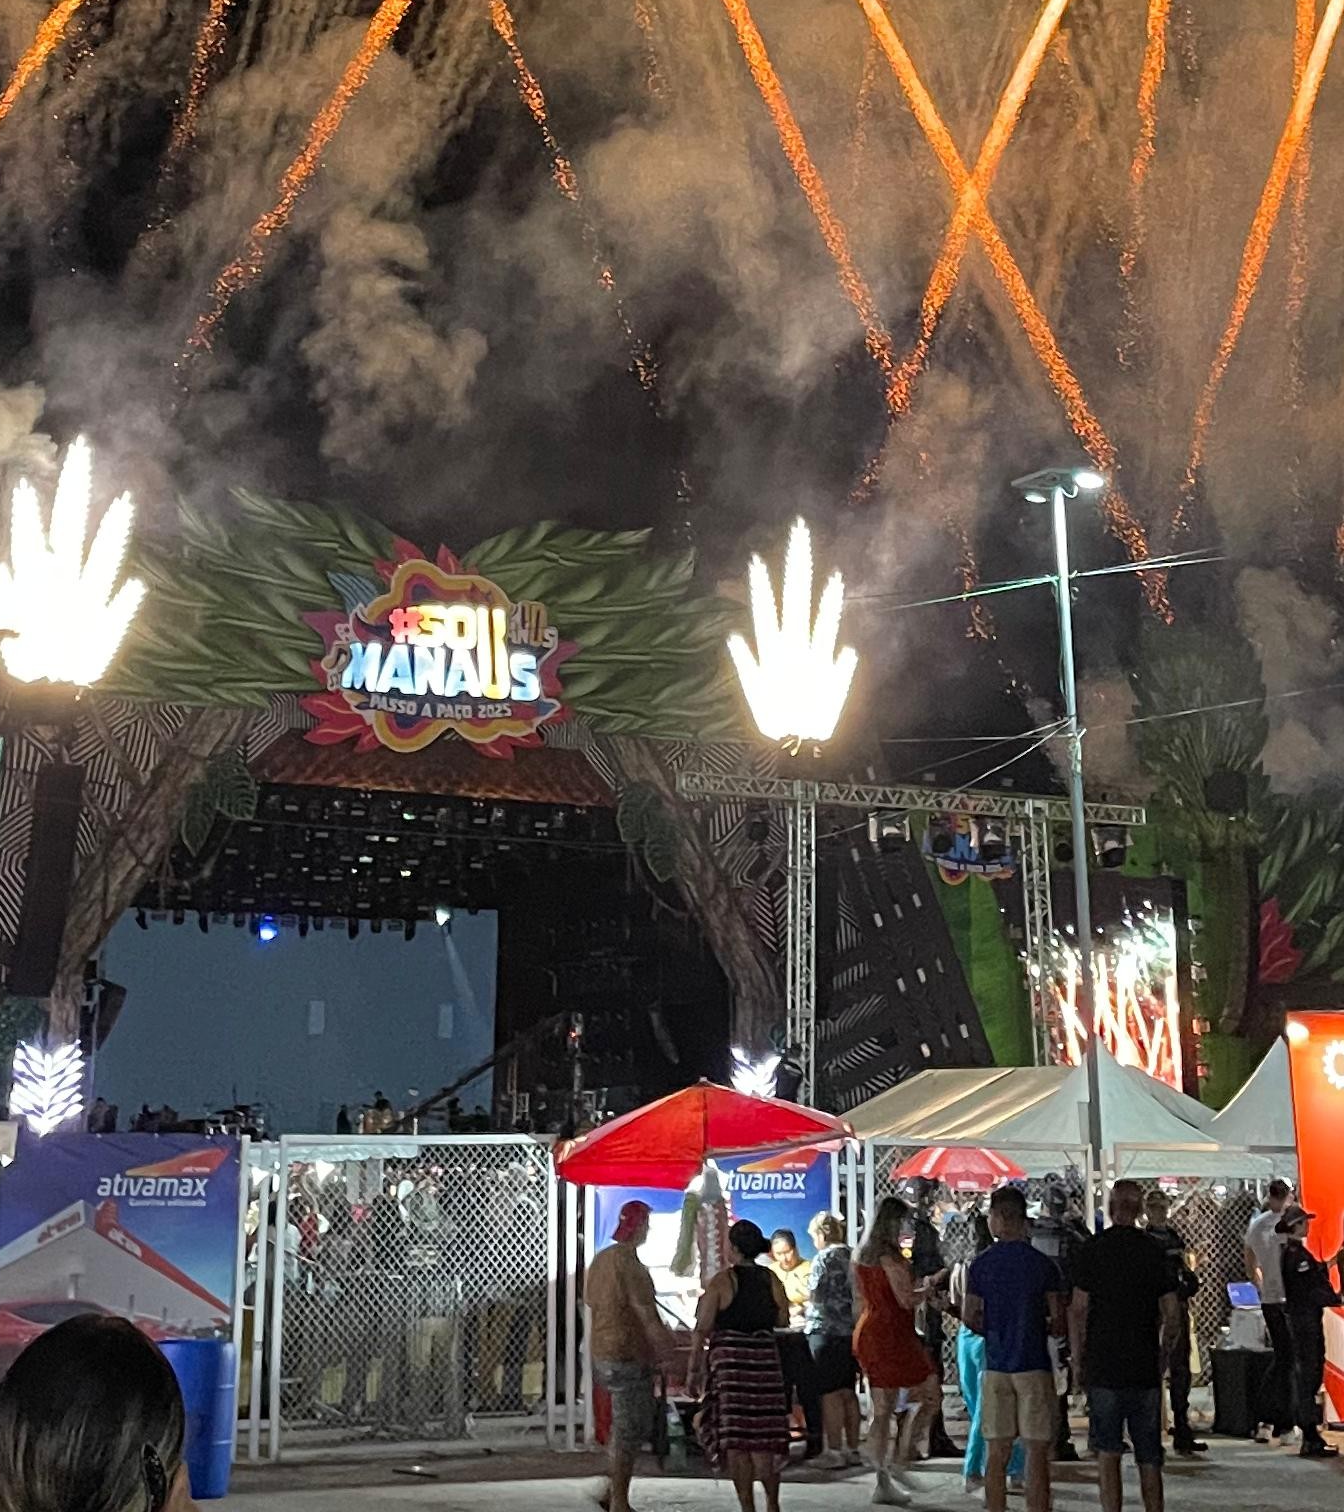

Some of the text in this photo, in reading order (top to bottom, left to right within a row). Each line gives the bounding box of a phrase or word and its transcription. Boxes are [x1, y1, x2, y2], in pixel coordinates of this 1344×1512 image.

[340, 641, 541, 701] MANAUS
[368, 693, 513, 720] PASSO A PAÇO 2025
[97, 1175, 209, 1197] ativamax
[728, 1169, 807, 1190] tivamax
